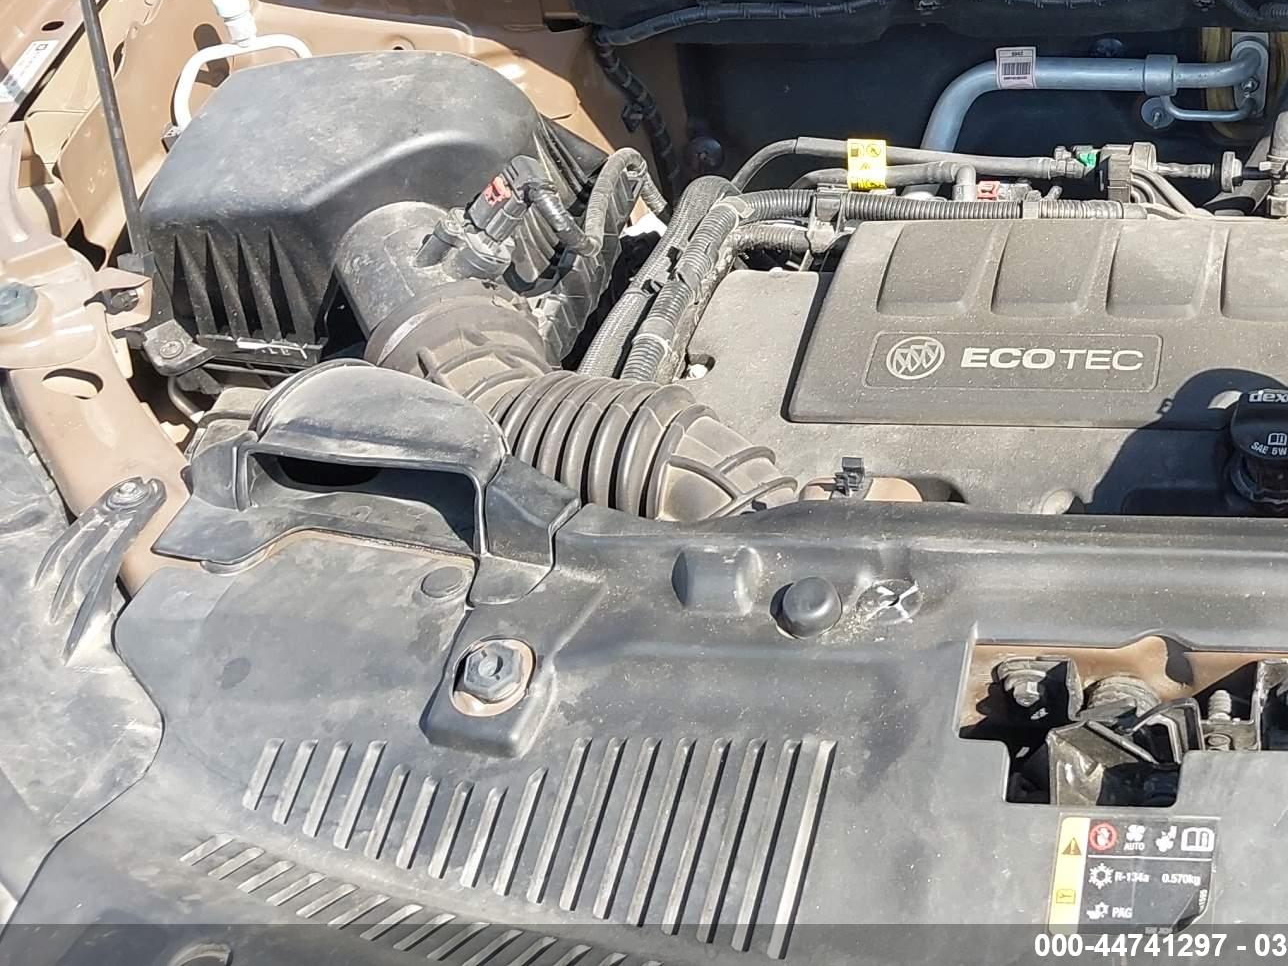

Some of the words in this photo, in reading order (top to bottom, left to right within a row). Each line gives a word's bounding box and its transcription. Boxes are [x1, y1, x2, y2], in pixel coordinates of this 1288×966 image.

[961, 347, 1144, 371] ECOTEC
[1251, 442, 1269, 454] SAE
[1123, 842, 1145, 851] AUTO
[1114, 872, 1150, 883] R-134a
[1161, 873, 1201, 886] 0.570kg
[1111, 907, 1133, 919] PAG
